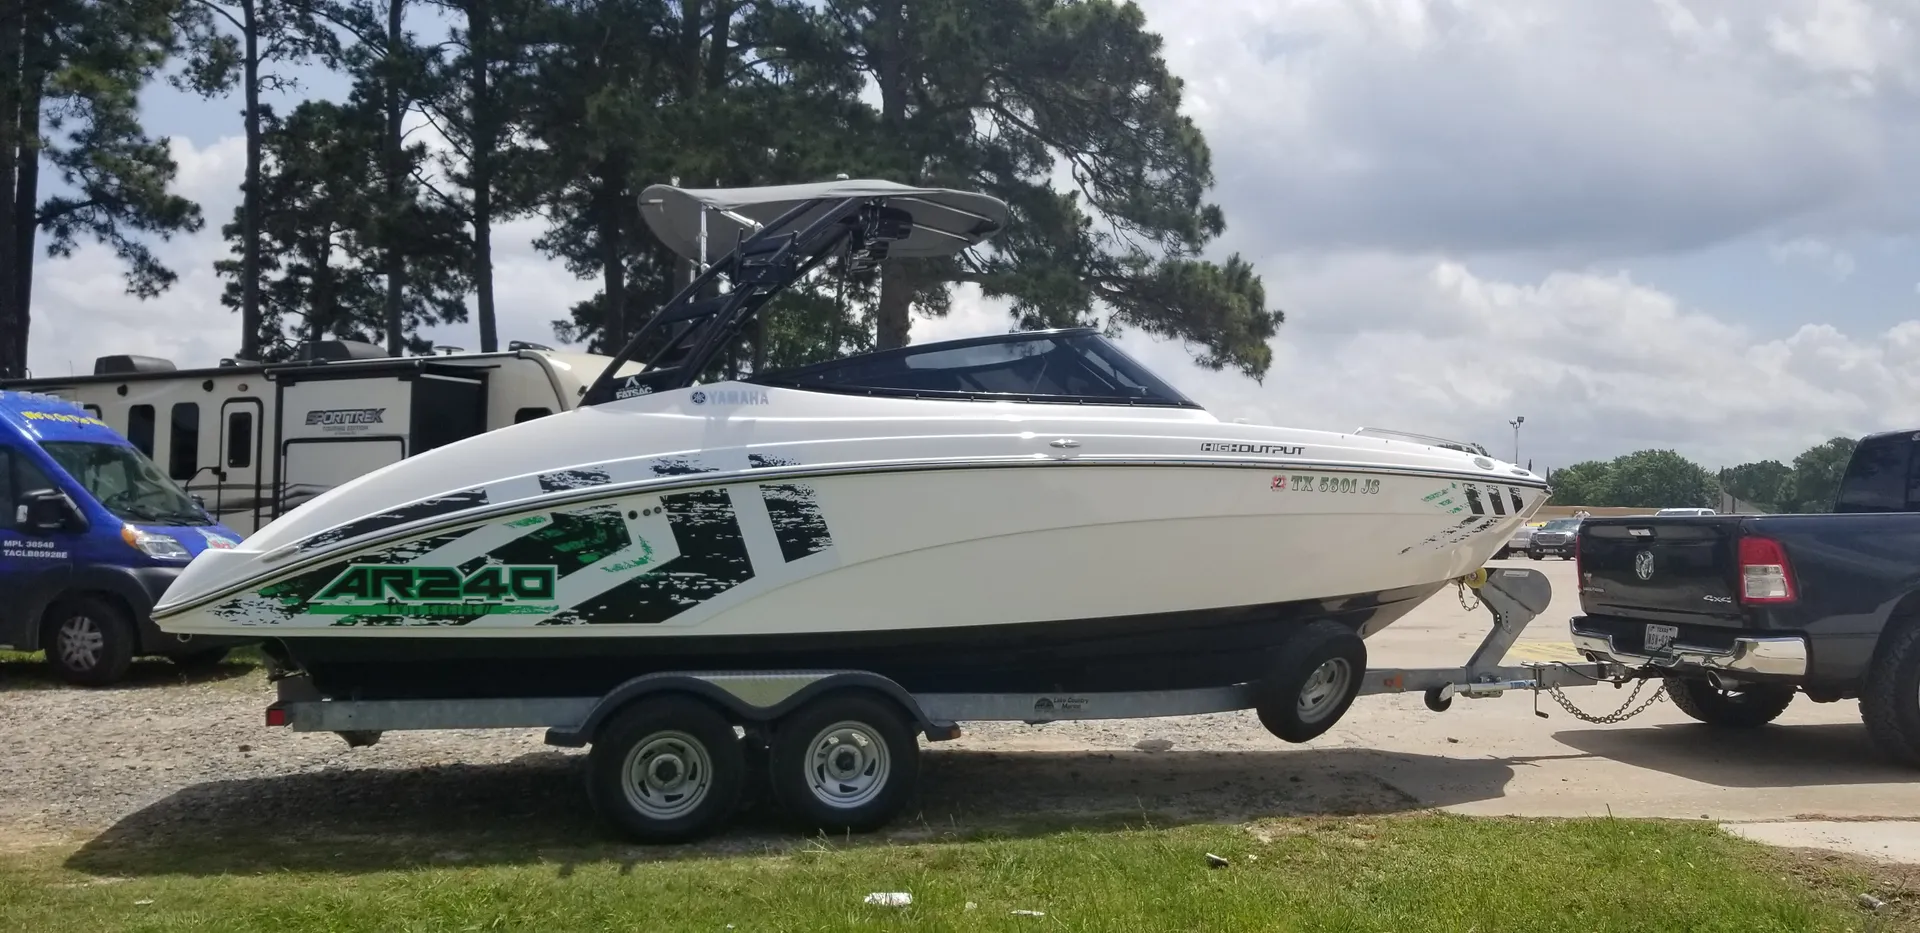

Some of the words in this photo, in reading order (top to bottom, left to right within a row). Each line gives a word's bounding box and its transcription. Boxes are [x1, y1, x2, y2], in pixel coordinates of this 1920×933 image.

[616, 386, 653, 399] FATSAC
[708, 391, 769, 405] YAMAHA
[305, 408, 386, 425] SPORTTREK
[1291, 475, 1314, 491] TX
[1319, 477, 1358, 493] 5801
[1360, 479, 1380, 494] JS
[314, 565, 556, 601] AR240
